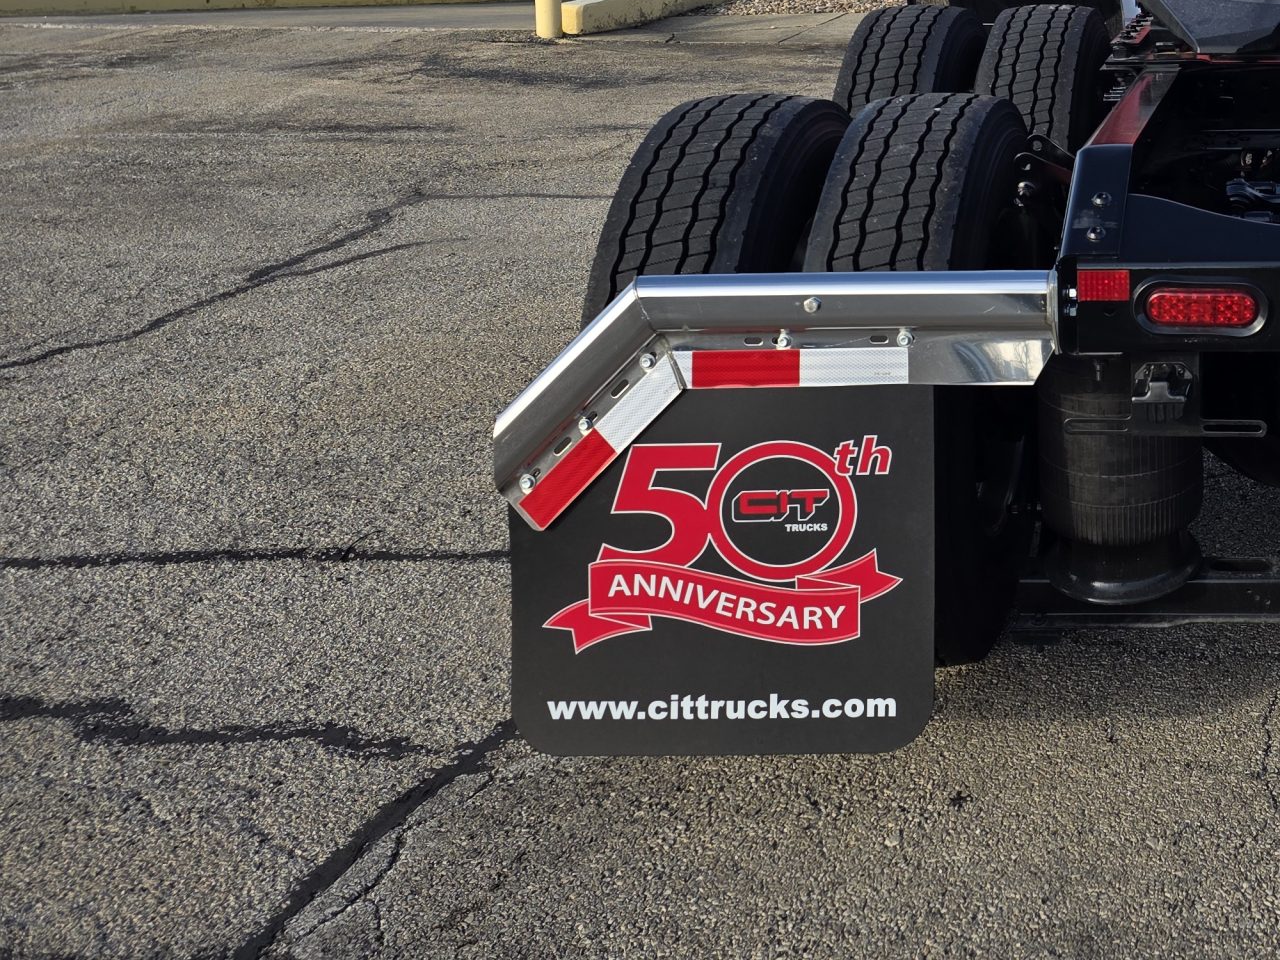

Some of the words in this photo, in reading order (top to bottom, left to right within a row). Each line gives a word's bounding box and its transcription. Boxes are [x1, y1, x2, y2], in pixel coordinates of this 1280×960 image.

[732, 488, 829, 522] CIT
[784, 523, 828, 532] TRUCKS
[607, 573, 846, 630] ANNIVERSARY
[547, 693, 897, 720] www.cittrucks.com
